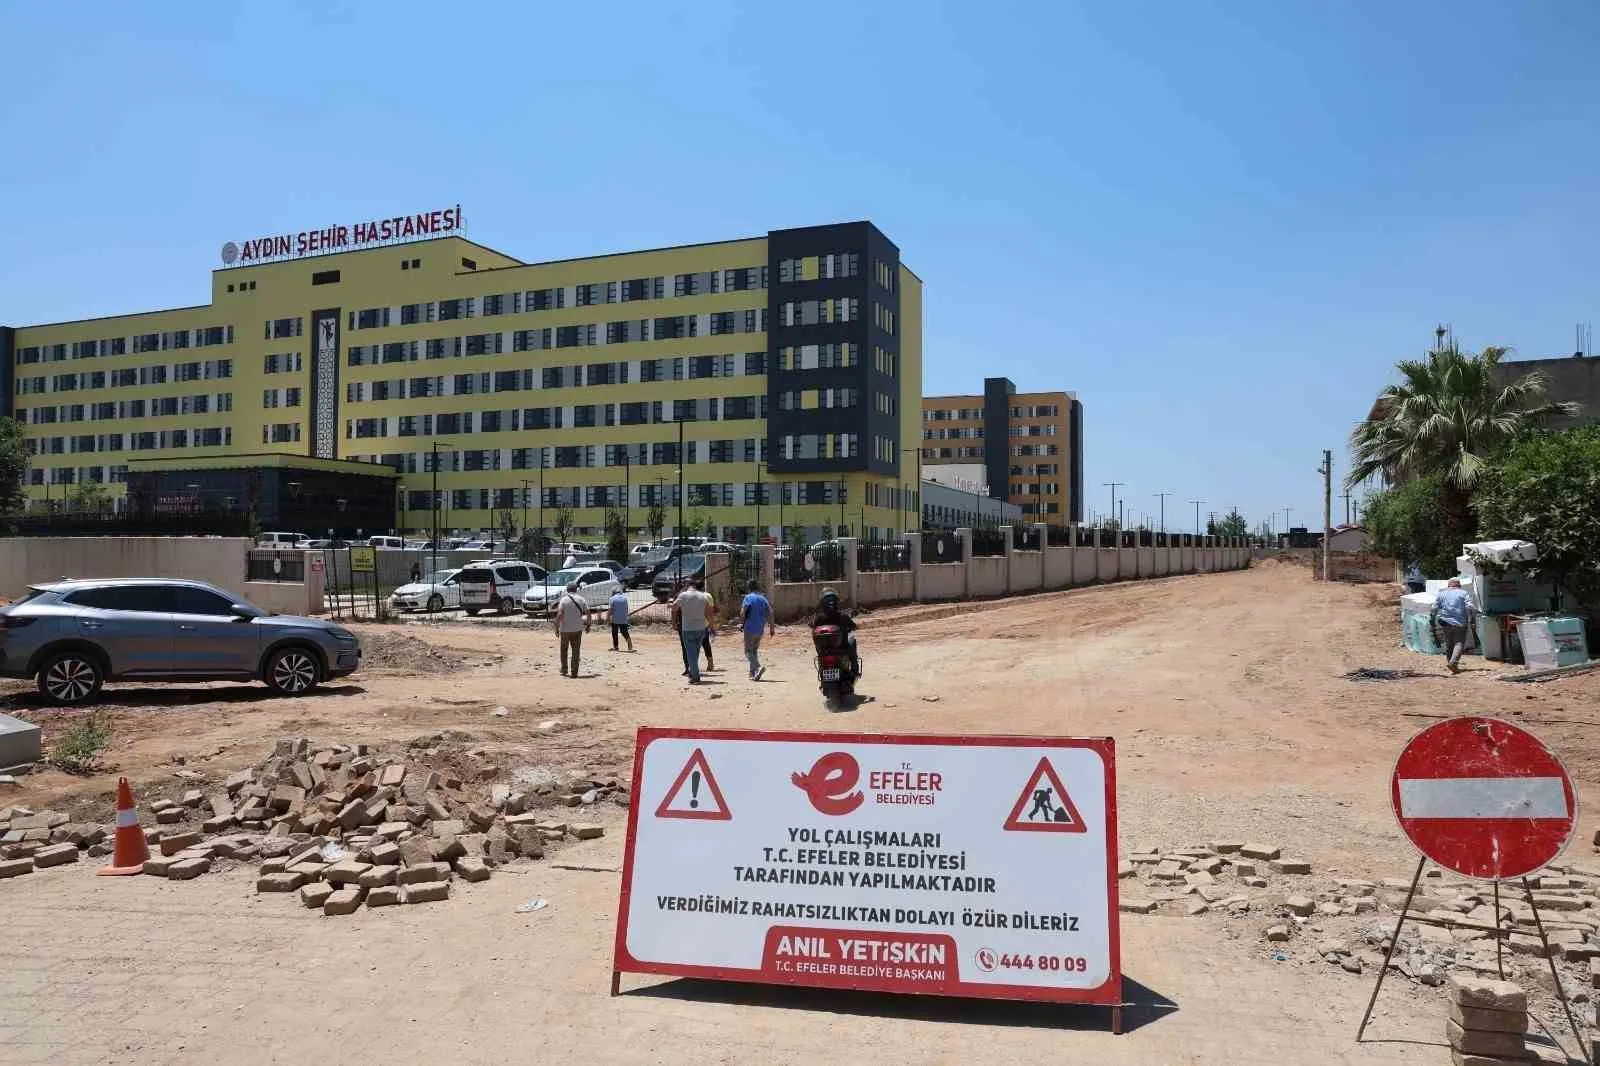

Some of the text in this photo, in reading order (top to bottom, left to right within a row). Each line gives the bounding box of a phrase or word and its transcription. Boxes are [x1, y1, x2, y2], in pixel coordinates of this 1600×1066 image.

[241, 203, 461, 261] AYDIN ŞEHİR HASTANESİ
[869, 771, 943, 791] EFELER
[876, 792, 935, 806] BELEDİYESİ
[788, 827, 941, 849] YOL ÇALIŞMALARI
[763, 847, 966, 871] T.C. EFELER BELEDİYESİ
[734, 866, 996, 893] TARAFINDAN YAPILMAKTADIR
[657, 895, 1080, 931] VERDİĞİMİZ RAHATSIZLIKTAN DOLAYI ÖZÜR DİLERİZ
[776, 936, 831, 958] ANIL
[775, 961, 945, 981] T.C. EFELER BELEDİYE BAŞKANI
[1000, 954, 1087, 972] 444 80 09
